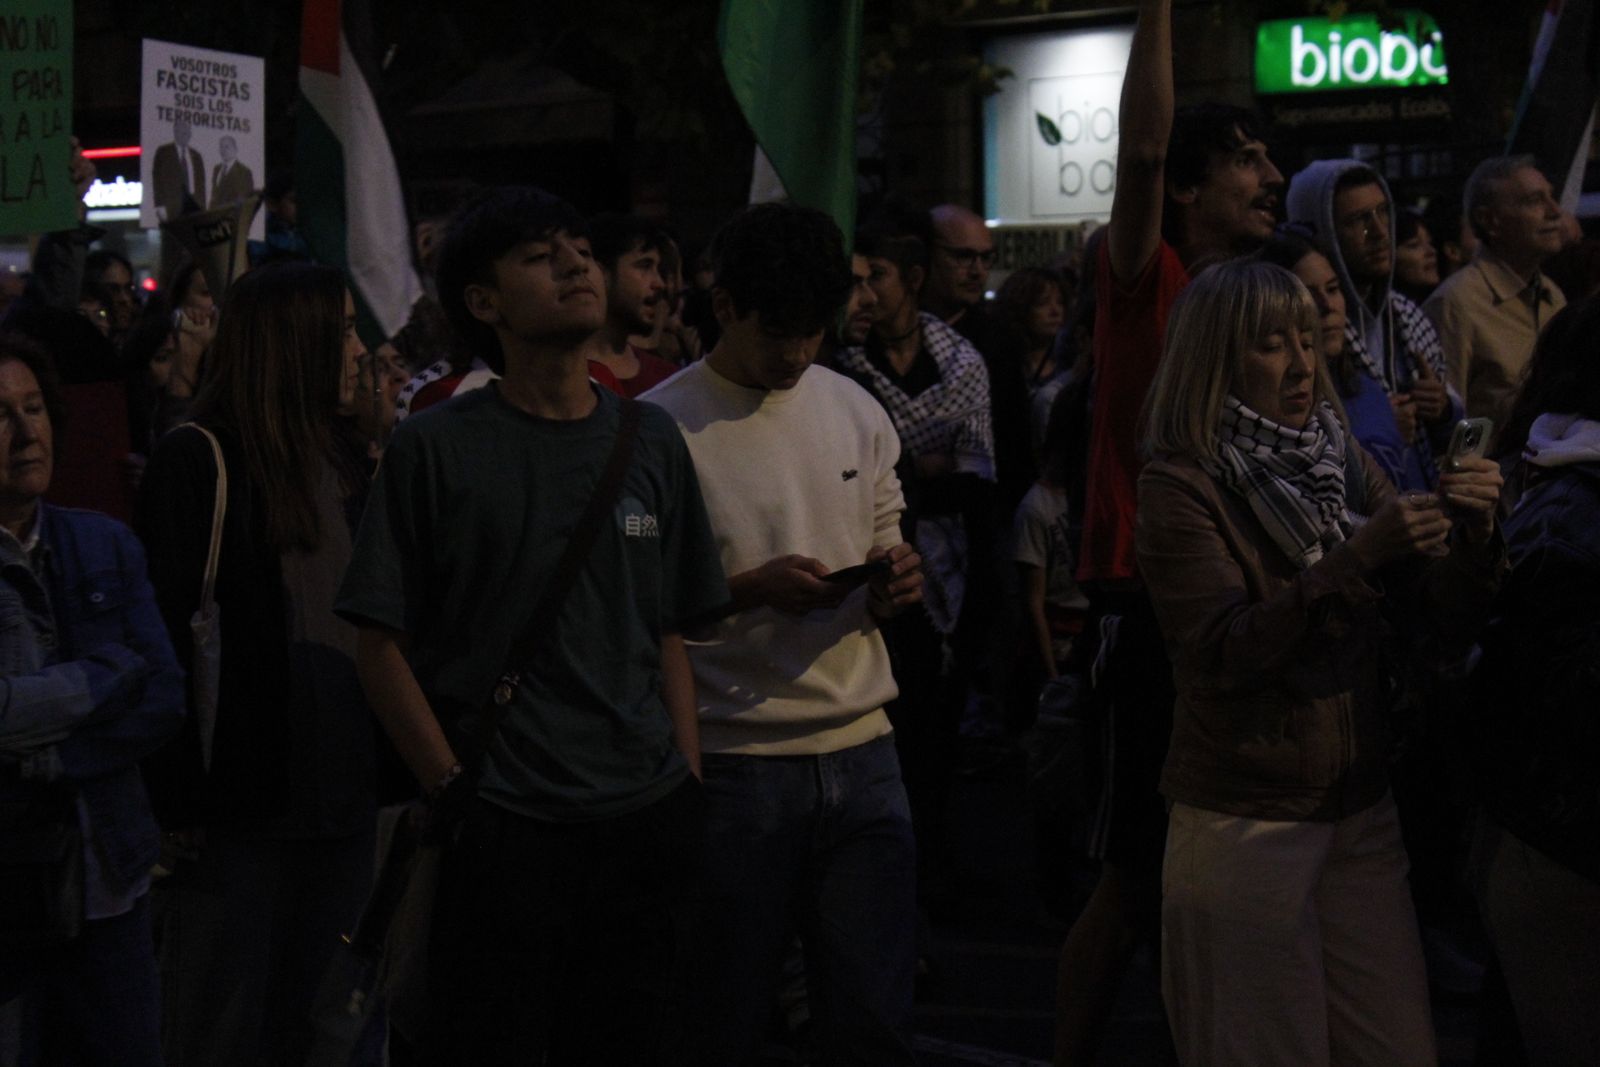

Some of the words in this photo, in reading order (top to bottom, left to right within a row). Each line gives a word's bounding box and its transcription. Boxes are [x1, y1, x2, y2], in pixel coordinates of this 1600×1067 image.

[36, 14, 58, 51] NO
[170, 55, 238, 79] VOSOTROS
[12, 66, 62, 101] PARA
[156, 69, 250, 101] FASCISTAS
[174, 92, 204, 110] SOIS
[208, 98, 233, 114] LOS
[42, 107, 62, 138] LA
[156, 105, 251, 133] TERRORISTAS
[625, 511, 660, 537] 自然
